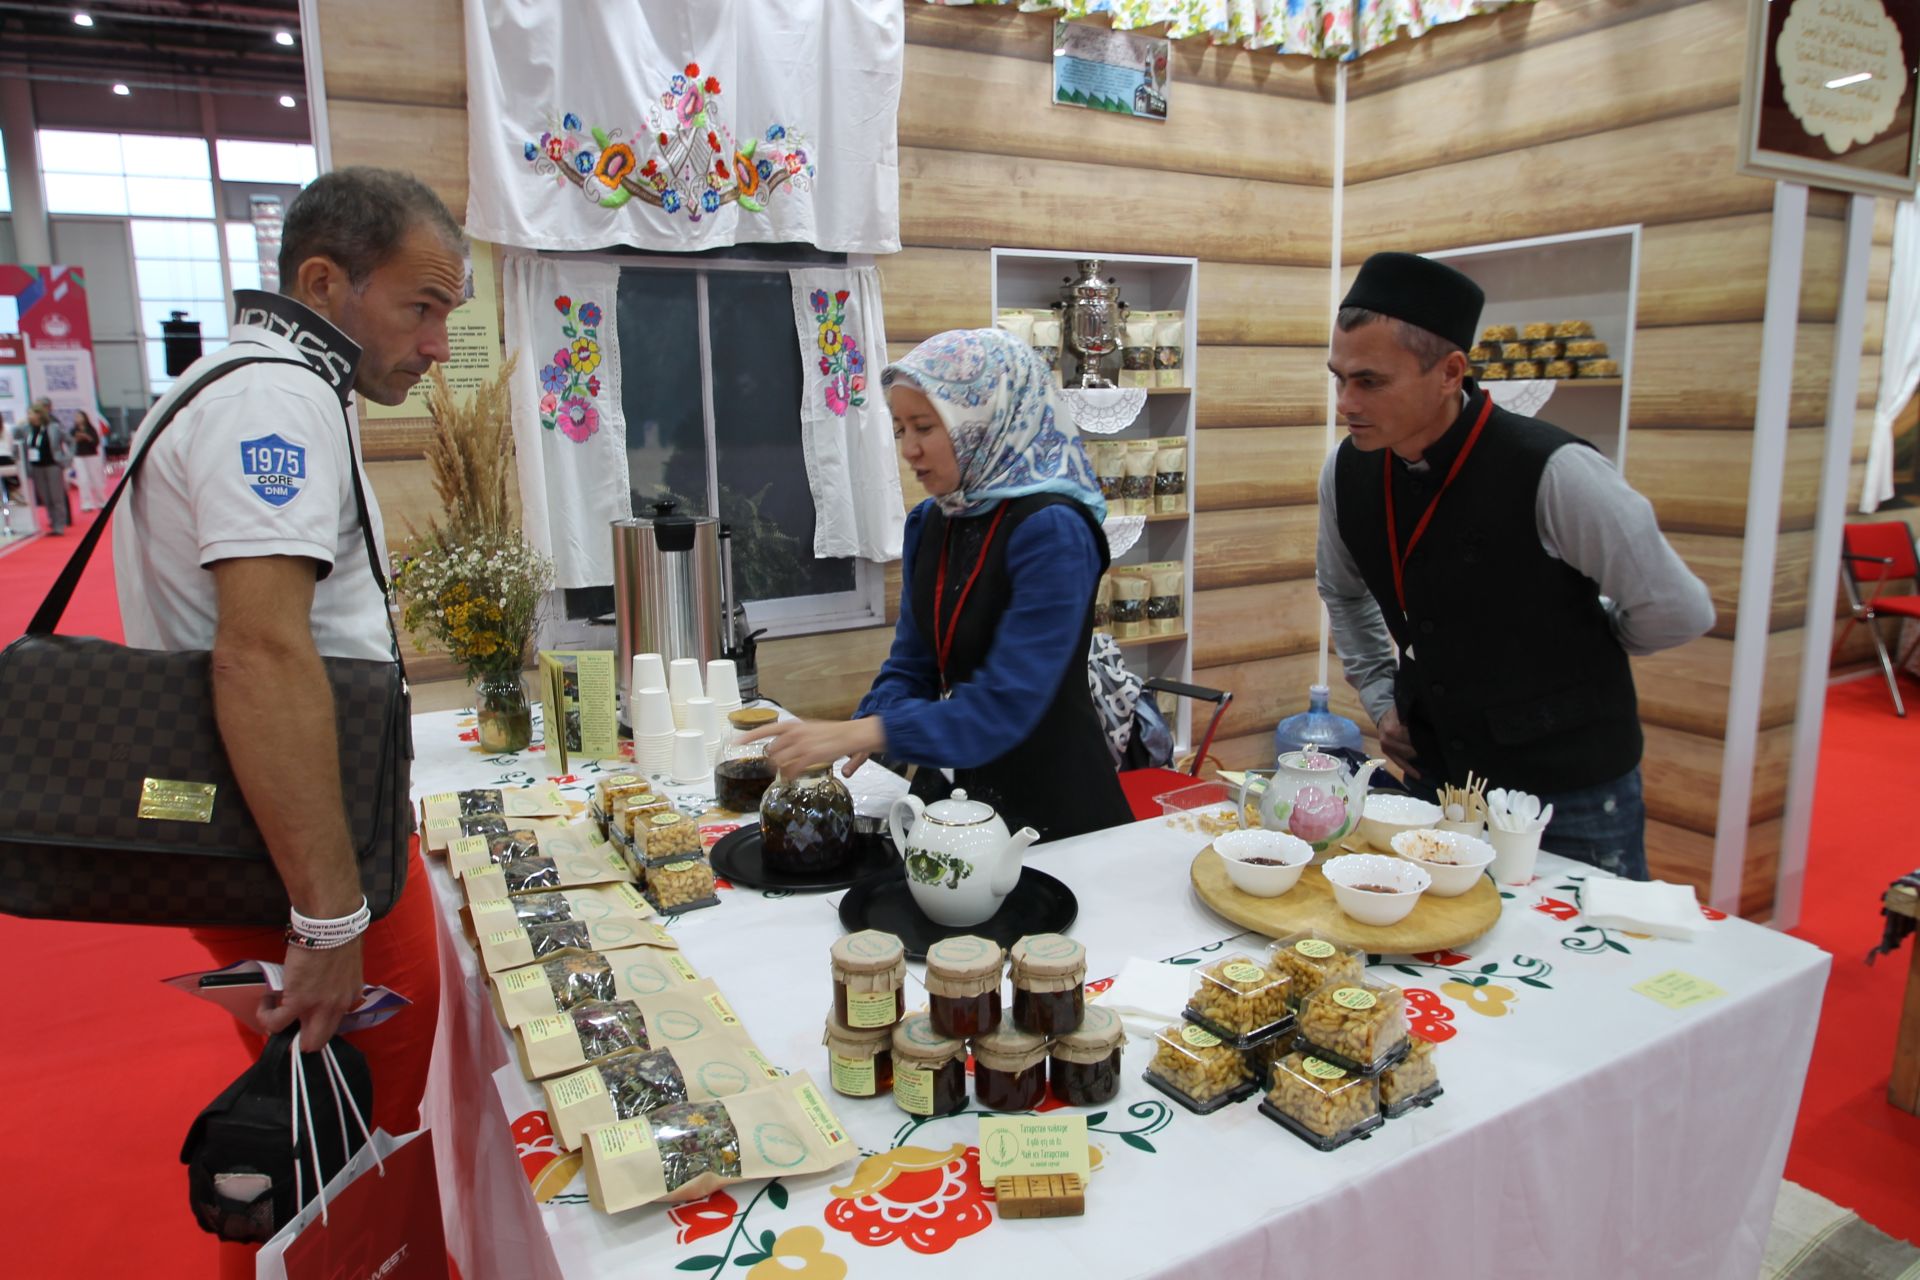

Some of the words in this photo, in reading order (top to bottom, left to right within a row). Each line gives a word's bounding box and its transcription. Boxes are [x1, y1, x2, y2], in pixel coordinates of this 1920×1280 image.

[247, 447, 300, 475] 1975
[257, 475, 294, 486] CORE
[265, 487, 289, 496] DNM
